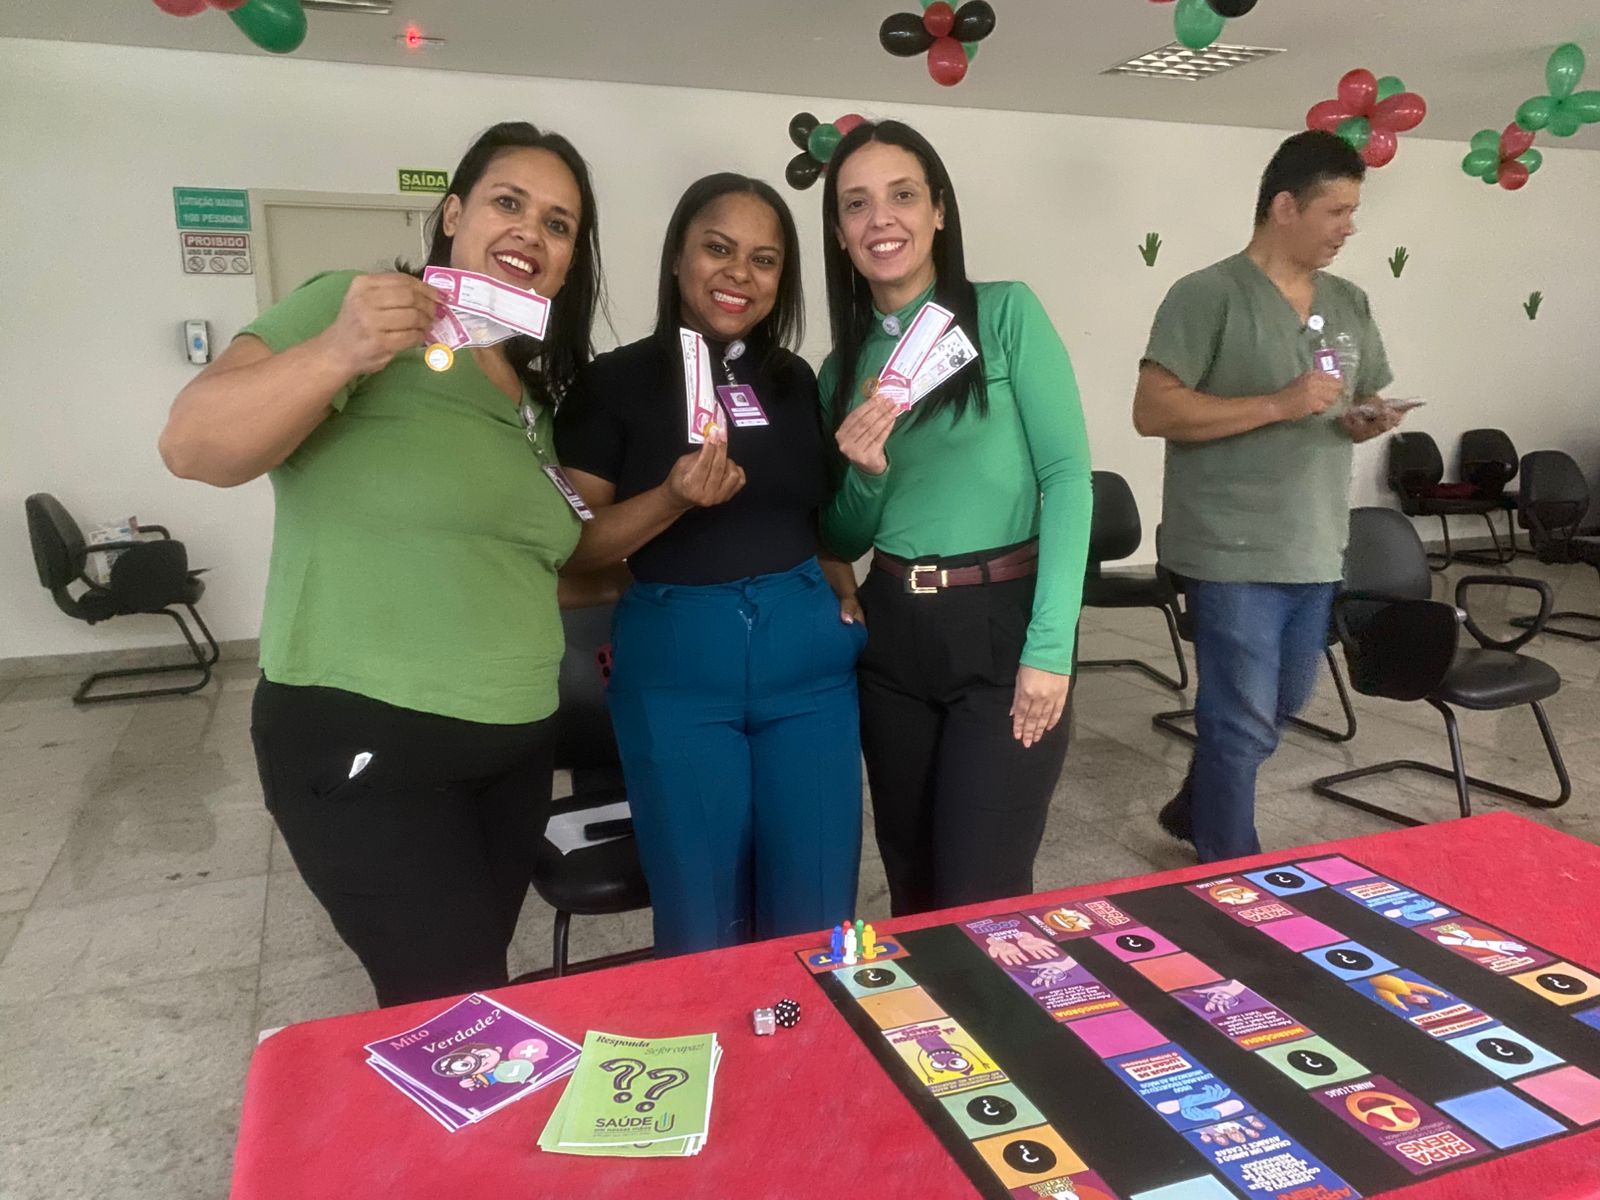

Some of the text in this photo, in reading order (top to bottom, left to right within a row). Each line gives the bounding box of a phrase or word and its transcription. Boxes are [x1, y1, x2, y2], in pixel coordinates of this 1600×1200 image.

[401, 172, 446, 187] SAÍDA
[187, 236, 244, 247] PROIBIDO
[421, 1009, 501, 1054] Verdade?
[389, 1029, 430, 1050] Mito
[596, 1035, 650, 1048] Responda
[1151, 1063, 1185, 1075] TROQUE
[595, 1115, 653, 1128] SAÚDE
